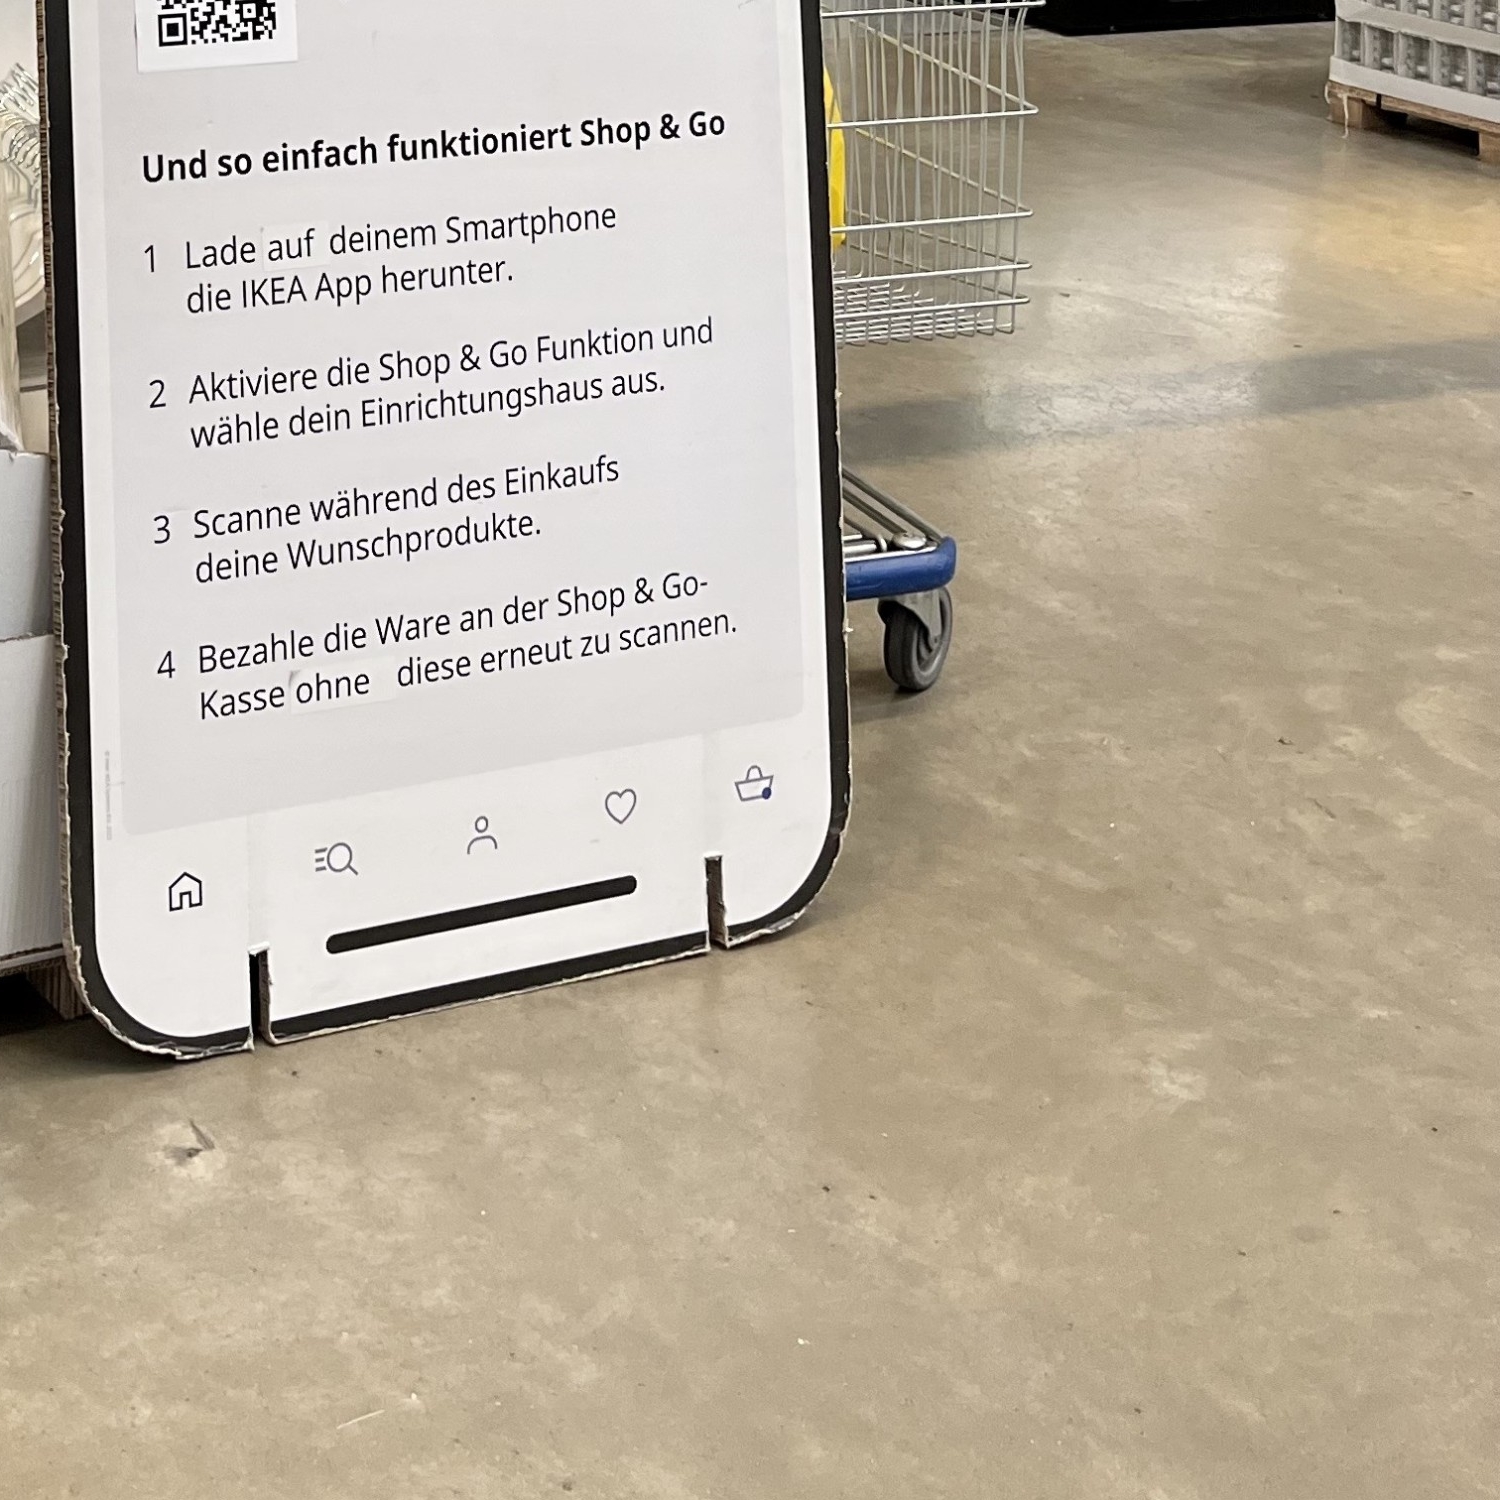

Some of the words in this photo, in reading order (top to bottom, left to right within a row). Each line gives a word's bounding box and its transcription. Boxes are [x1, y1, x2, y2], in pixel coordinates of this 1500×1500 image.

[143, 149, 206, 182] Und
[218, 154, 251, 176] so
[263, 136, 377, 172] einfach
[387, 124, 572, 162] funktioniert
[581, 118, 650, 150] Shop
[660, 114, 680, 139] &
[689, 111, 724, 136] Go
[145, 245, 154, 272] 1
[187, 235, 255, 268] Lade
[268, 228, 315, 261] auf
[330, 224, 436, 254] deinem
[446, 206, 615, 244] Smartphone
[188, 283, 230, 313] die
[243, 276, 307, 308] IKEA
[315, 273, 371, 306] App
[382, 260, 512, 293] herunter.
[150, 380, 166, 408] 2
[189, 367, 317, 404] Aktiviere
[328, 357, 369, 387] die
[380, 351, 450, 383] Shop
[460, 344, 481, 371] &
[490, 341, 527, 367] Go
[538, 327, 653, 362] Funktion
[664, 316, 712, 347] und
[191, 412, 278, 448] wähle
[290, 404, 350, 436] dein
[361, 372, 602, 427] Einrichtungshaus
[612, 372, 664, 396] aus.
[154, 515, 170, 544] 3
[194, 504, 300, 538] Scanne
[310, 480, 437, 521] während
[448, 474, 495, 503] des
[506, 455, 618, 495] Einkaufs
[196, 550, 277, 583] deine
[287, 510, 541, 569] Wunschprodukte.
[158, 651, 175, 678] 4
[200, 630, 313, 673] Bezahle
[324, 623, 366, 653] die
[375, 615, 450, 644] Ware
[460, 608, 492, 631] an
[504, 596, 549, 624] der
[558, 586, 624, 616] Shop
[635, 578, 654, 604] &
[663, 573, 707, 599] Go-
[201, 687, 284, 719] Kasse
[297, 673, 369, 703] ohne
[398, 657, 470, 686] diese
[481, 636, 572, 673] erneut
[581, 633, 609, 657] zu
[619, 611, 737, 650] scannen.
